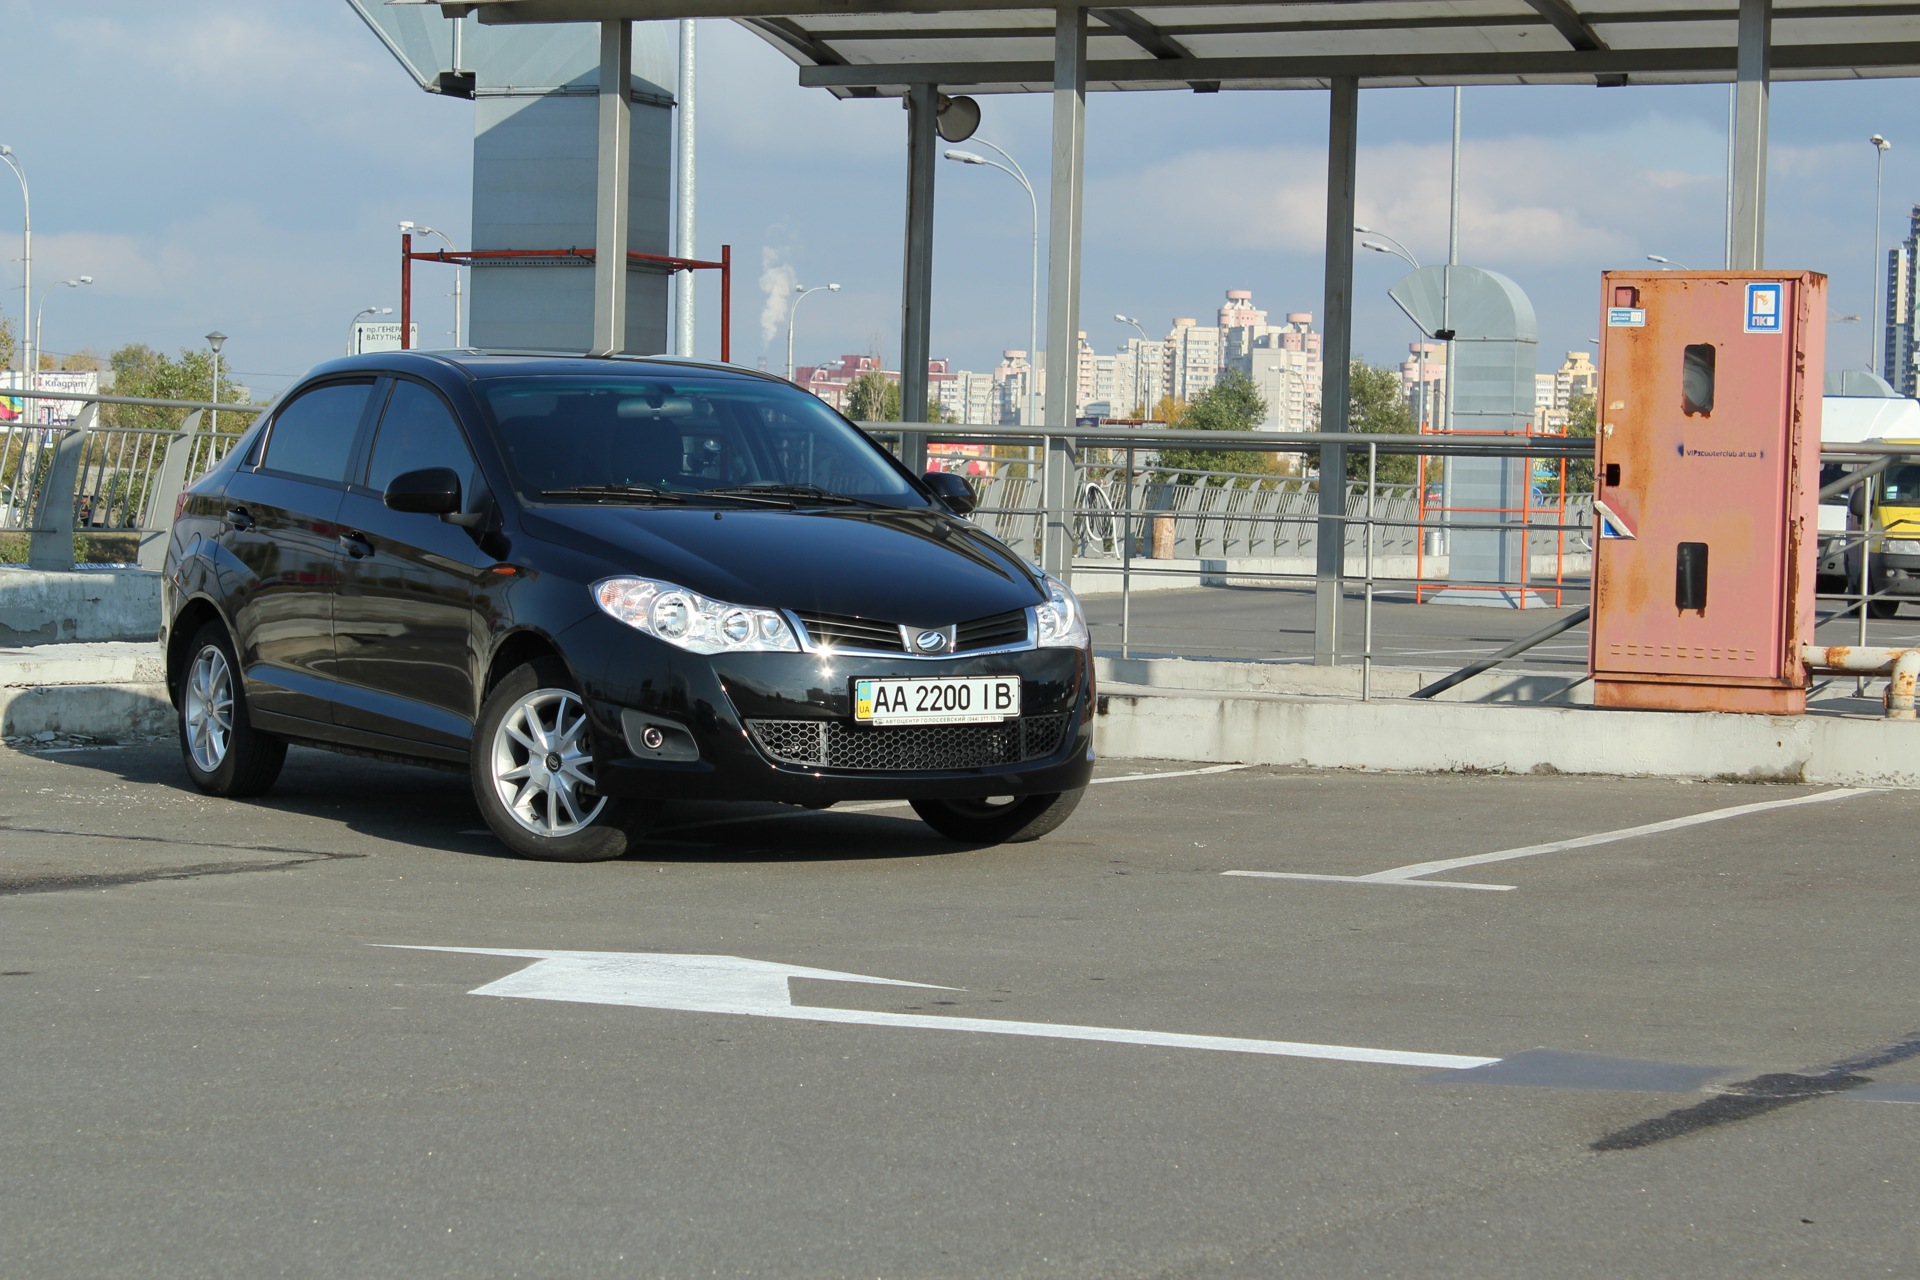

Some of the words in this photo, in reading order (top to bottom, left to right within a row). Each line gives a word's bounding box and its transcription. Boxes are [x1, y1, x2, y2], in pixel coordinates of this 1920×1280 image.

[366, 326, 416, 334] пр.ГЕНЕРА
[873, 686, 908, 713] AA
[915, 684, 971, 712] 2200
[859, 706, 870, 714] UA
[885, 717, 919, 725] АВТОЦЕНТР
